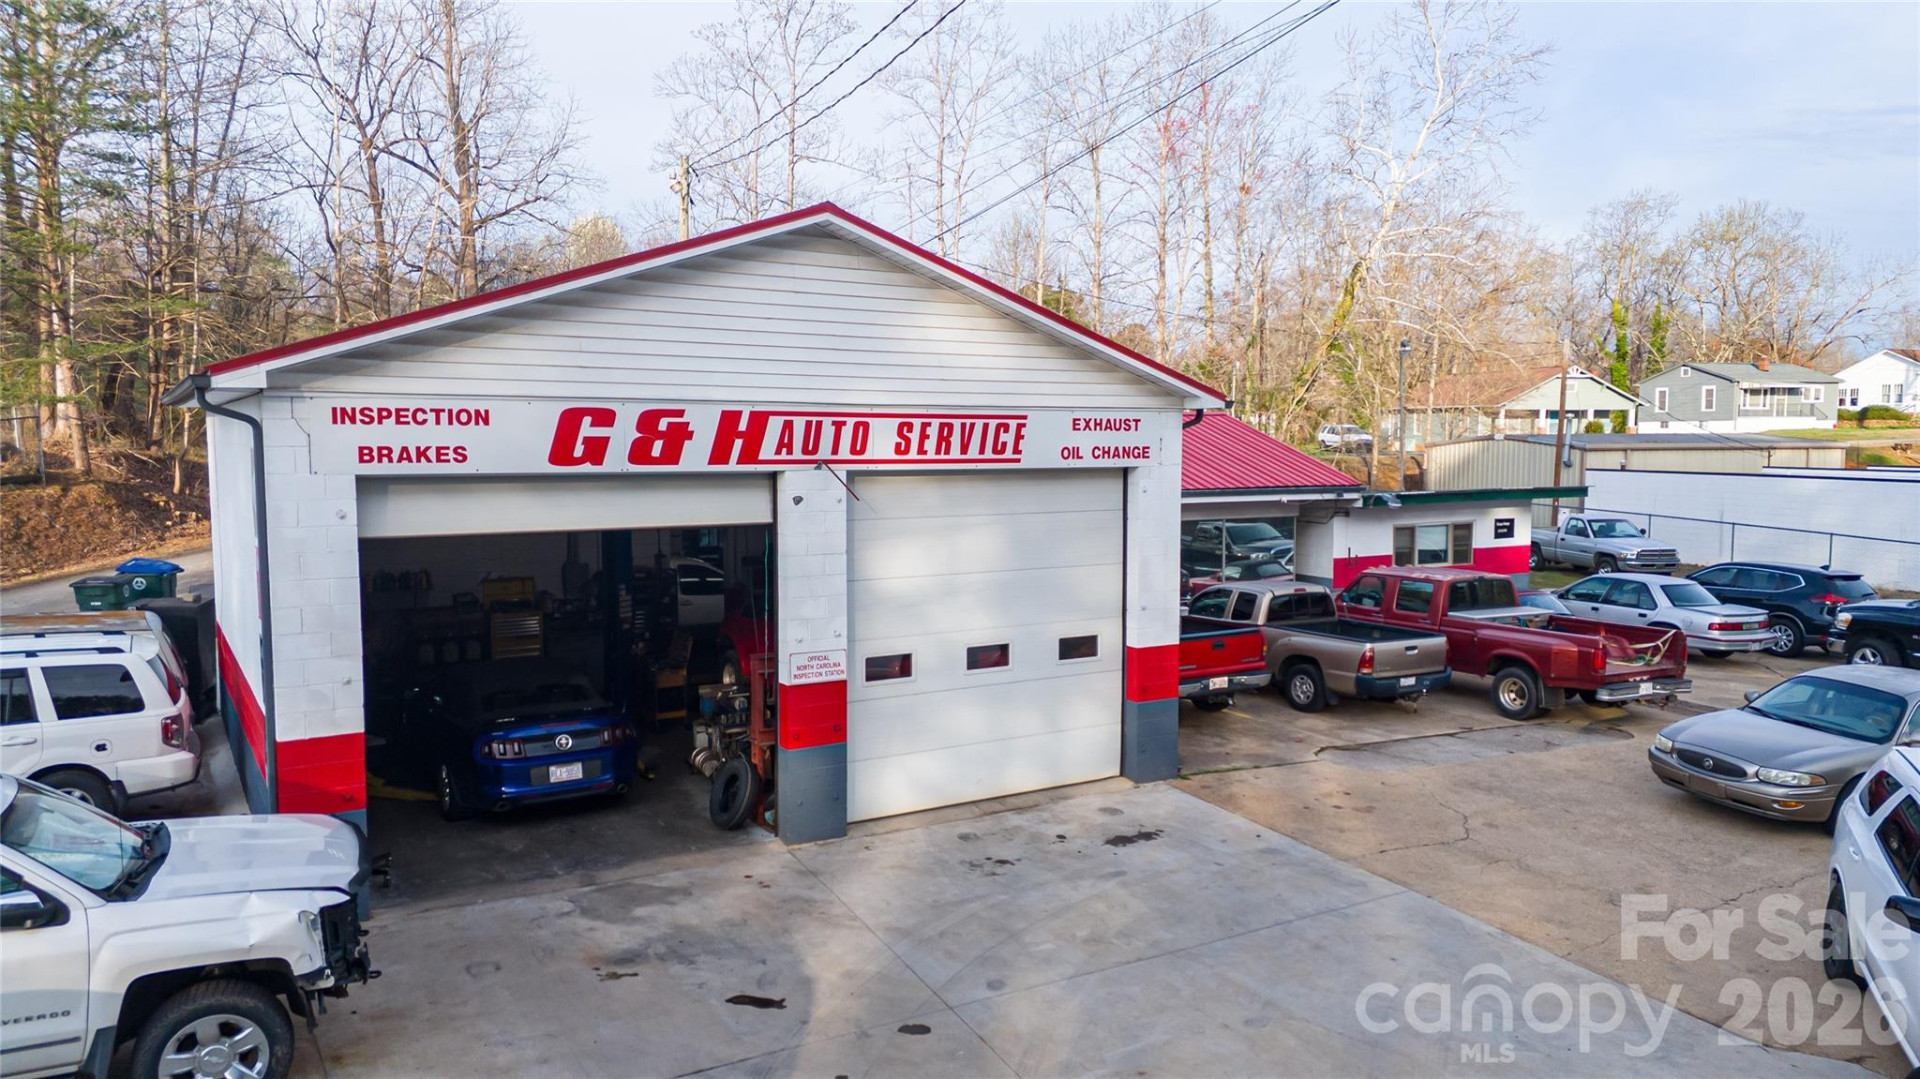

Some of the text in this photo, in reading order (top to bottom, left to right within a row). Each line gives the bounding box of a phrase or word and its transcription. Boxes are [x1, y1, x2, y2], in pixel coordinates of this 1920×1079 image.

[331, 406, 491, 427] INSPECTION
[1072, 417, 1141, 432] EXHAUST
[548, 407, 1028, 467] G & H AUTO SERVICE
[357, 445, 468, 465] BRAKES
[1061, 445, 1150, 461] OIL CHANGE
[793, 669, 845, 679] INSPECTION STATION
[815, 662, 841, 670] CAROLINA
